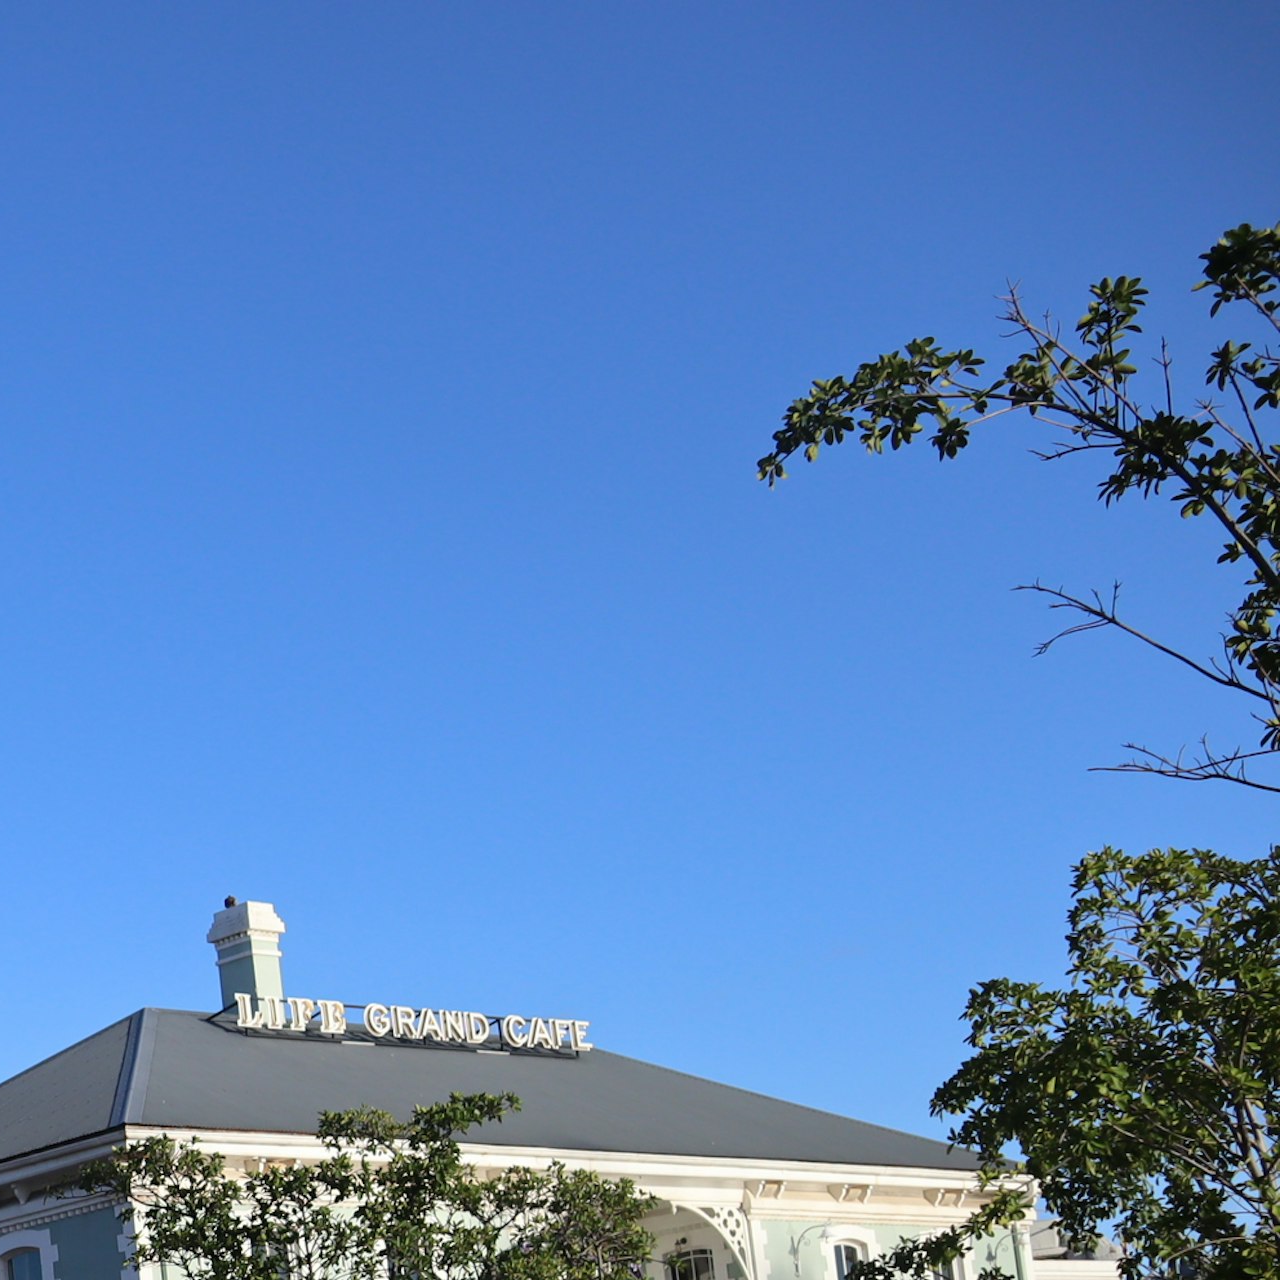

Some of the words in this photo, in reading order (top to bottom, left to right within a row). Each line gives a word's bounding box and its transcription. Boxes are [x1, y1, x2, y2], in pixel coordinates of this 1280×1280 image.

[234, 992, 347, 1035] LIFE
[363, 1002, 490, 1045] GRAND
[502, 1013, 594, 1052] CAFE
